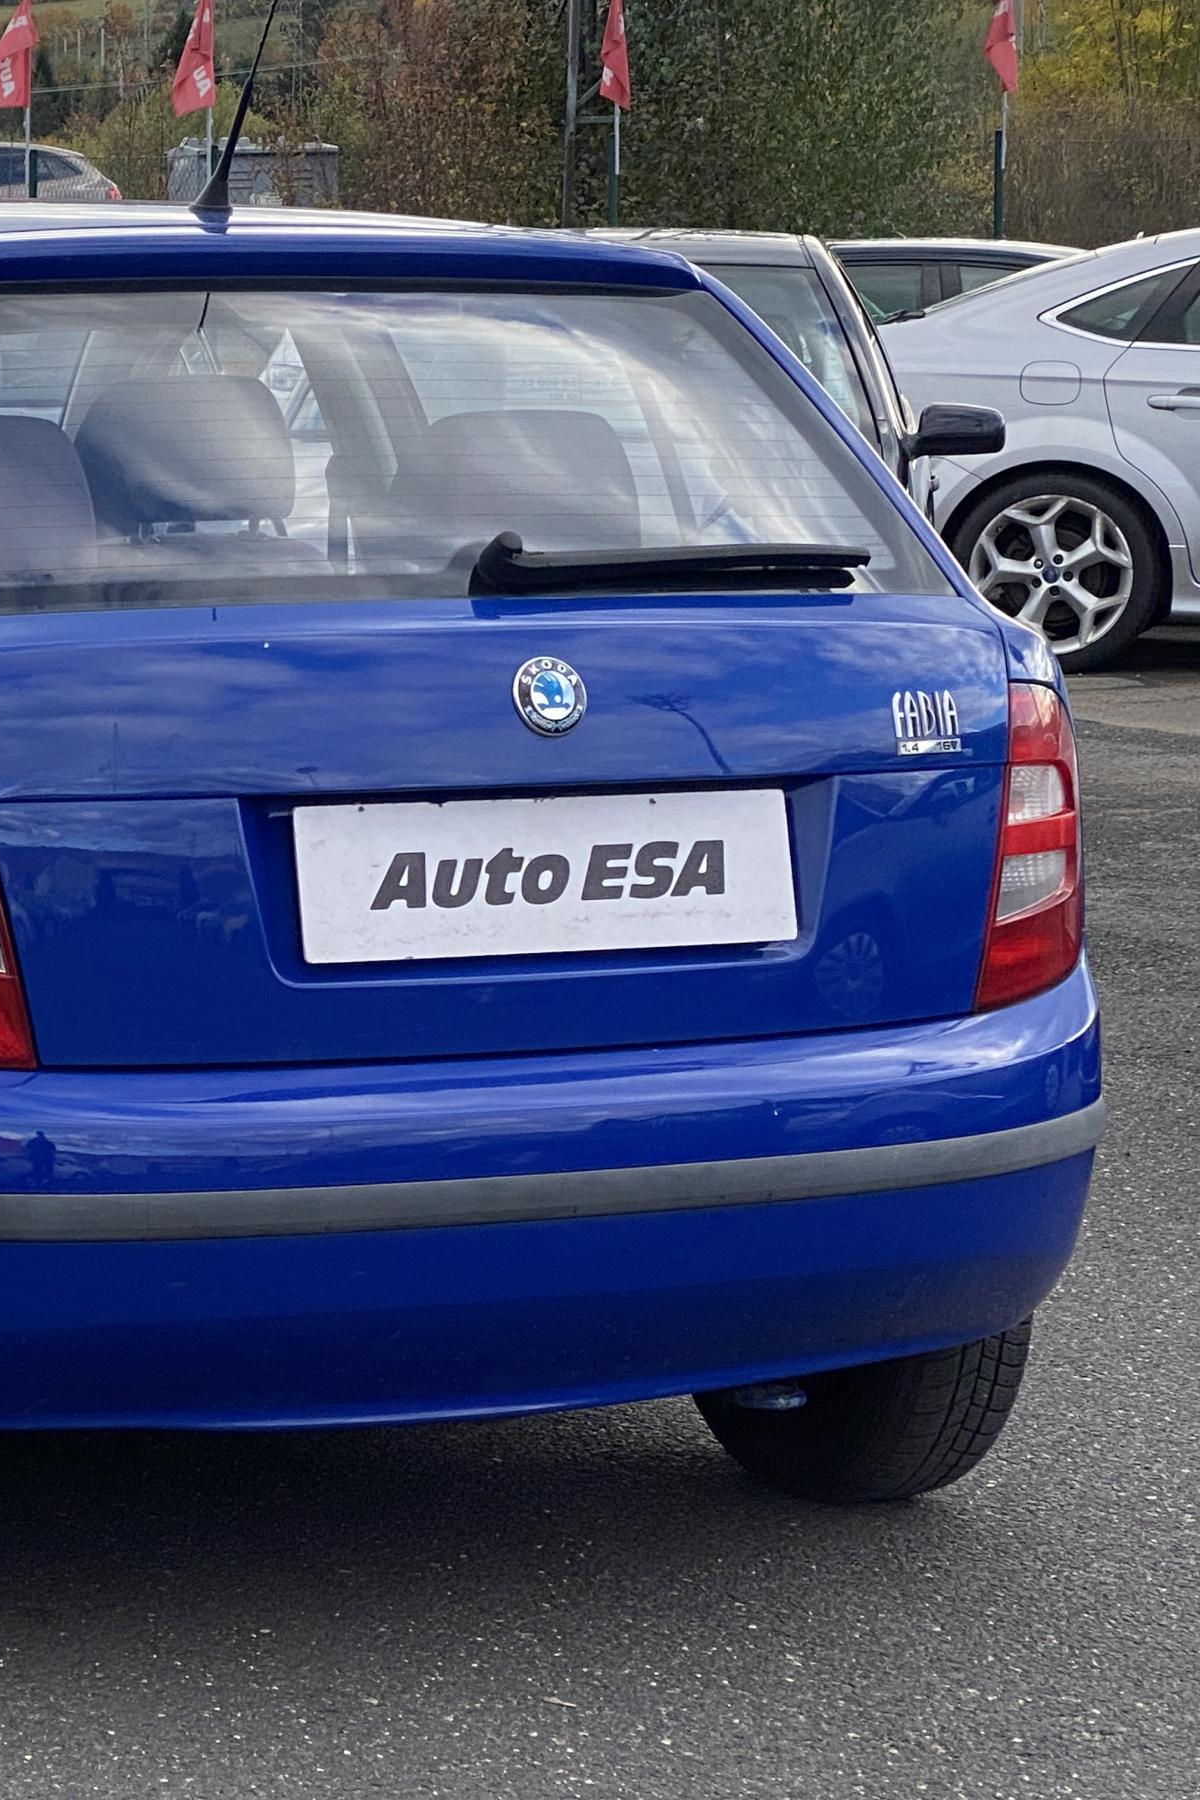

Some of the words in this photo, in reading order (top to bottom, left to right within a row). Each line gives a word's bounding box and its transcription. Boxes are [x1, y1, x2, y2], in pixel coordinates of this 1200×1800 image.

[892, 689, 959, 738] FABIA
[901, 743, 919, 753] 1.4
[935, 740, 958, 751] 16V
[370, 847, 570, 910] Auto
[581, 839, 726, 900] ESA
